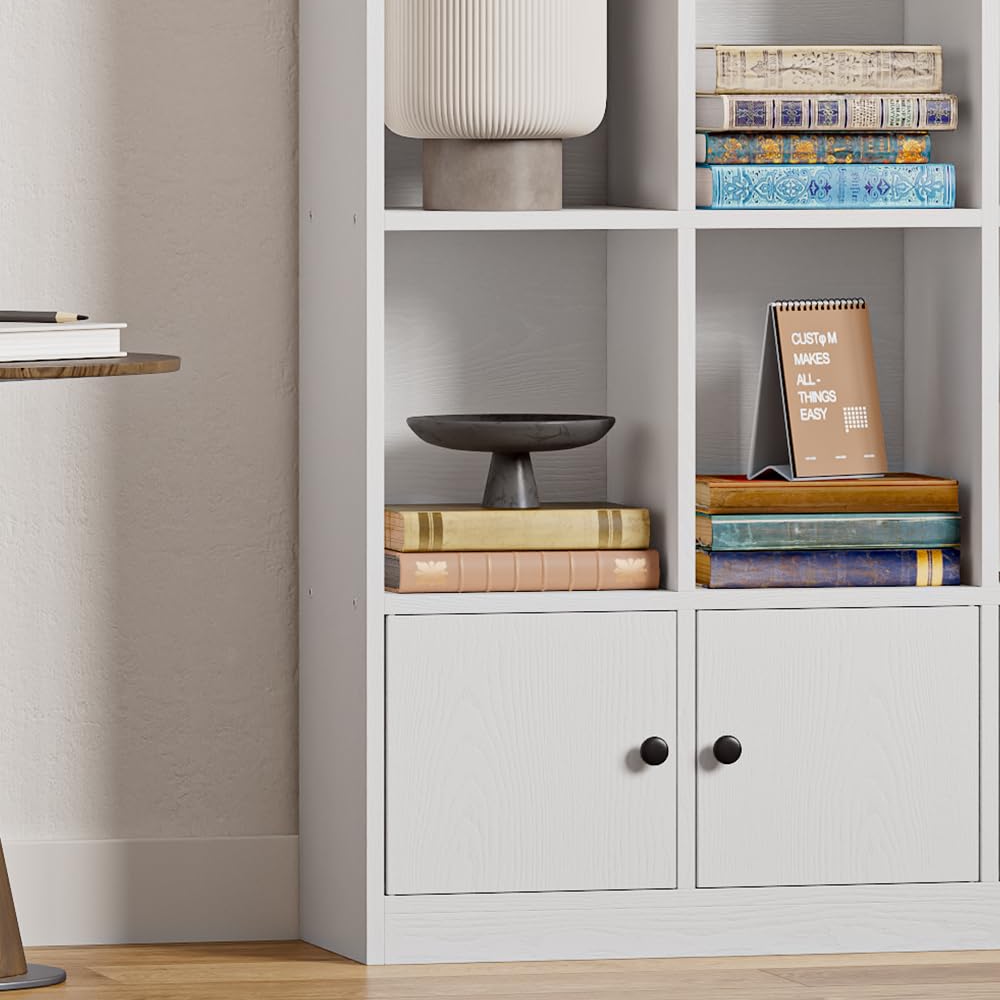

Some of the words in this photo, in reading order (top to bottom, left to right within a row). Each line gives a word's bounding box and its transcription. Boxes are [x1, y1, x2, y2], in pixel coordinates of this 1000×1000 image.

[793, 352, 831, 366] MAKES
[797, 389, 838, 404] THINGS
[800, 406, 828, 421] EASY
